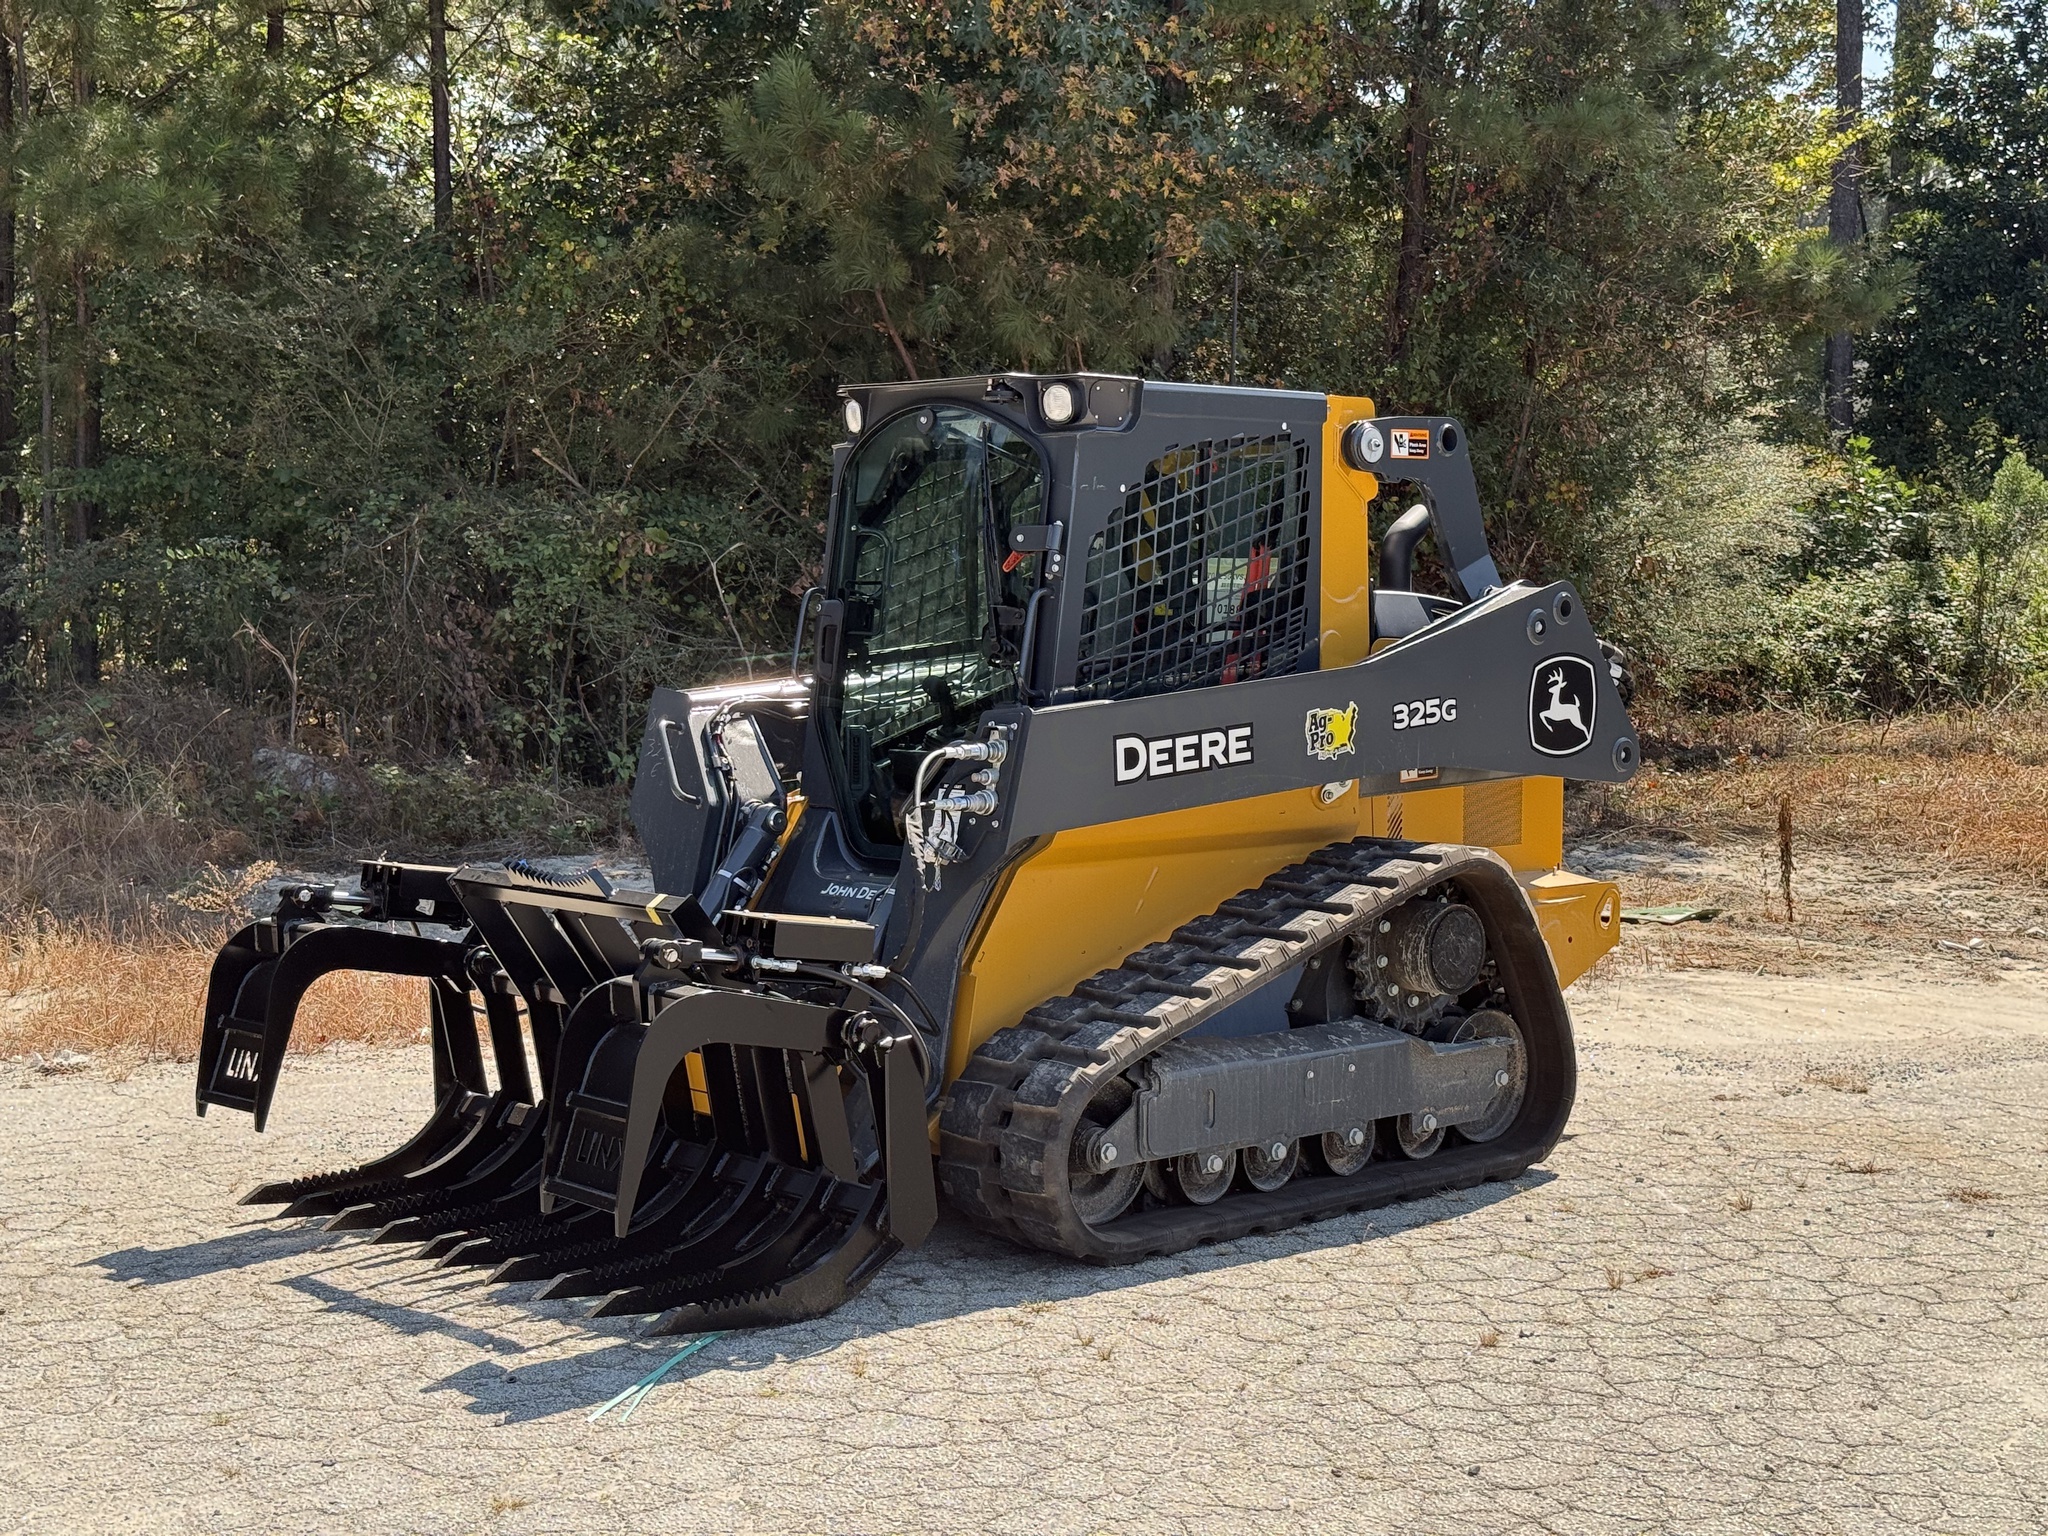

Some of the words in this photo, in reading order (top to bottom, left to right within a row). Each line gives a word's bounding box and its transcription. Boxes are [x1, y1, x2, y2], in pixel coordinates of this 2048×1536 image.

[1393, 698, 1457, 730] 325G
[1115, 726, 1252, 782] DEERE
[1310, 732, 1334, 751] Pro
[820, 882, 858, 898] JOHN
[226, 1047, 259, 1082] LIN
